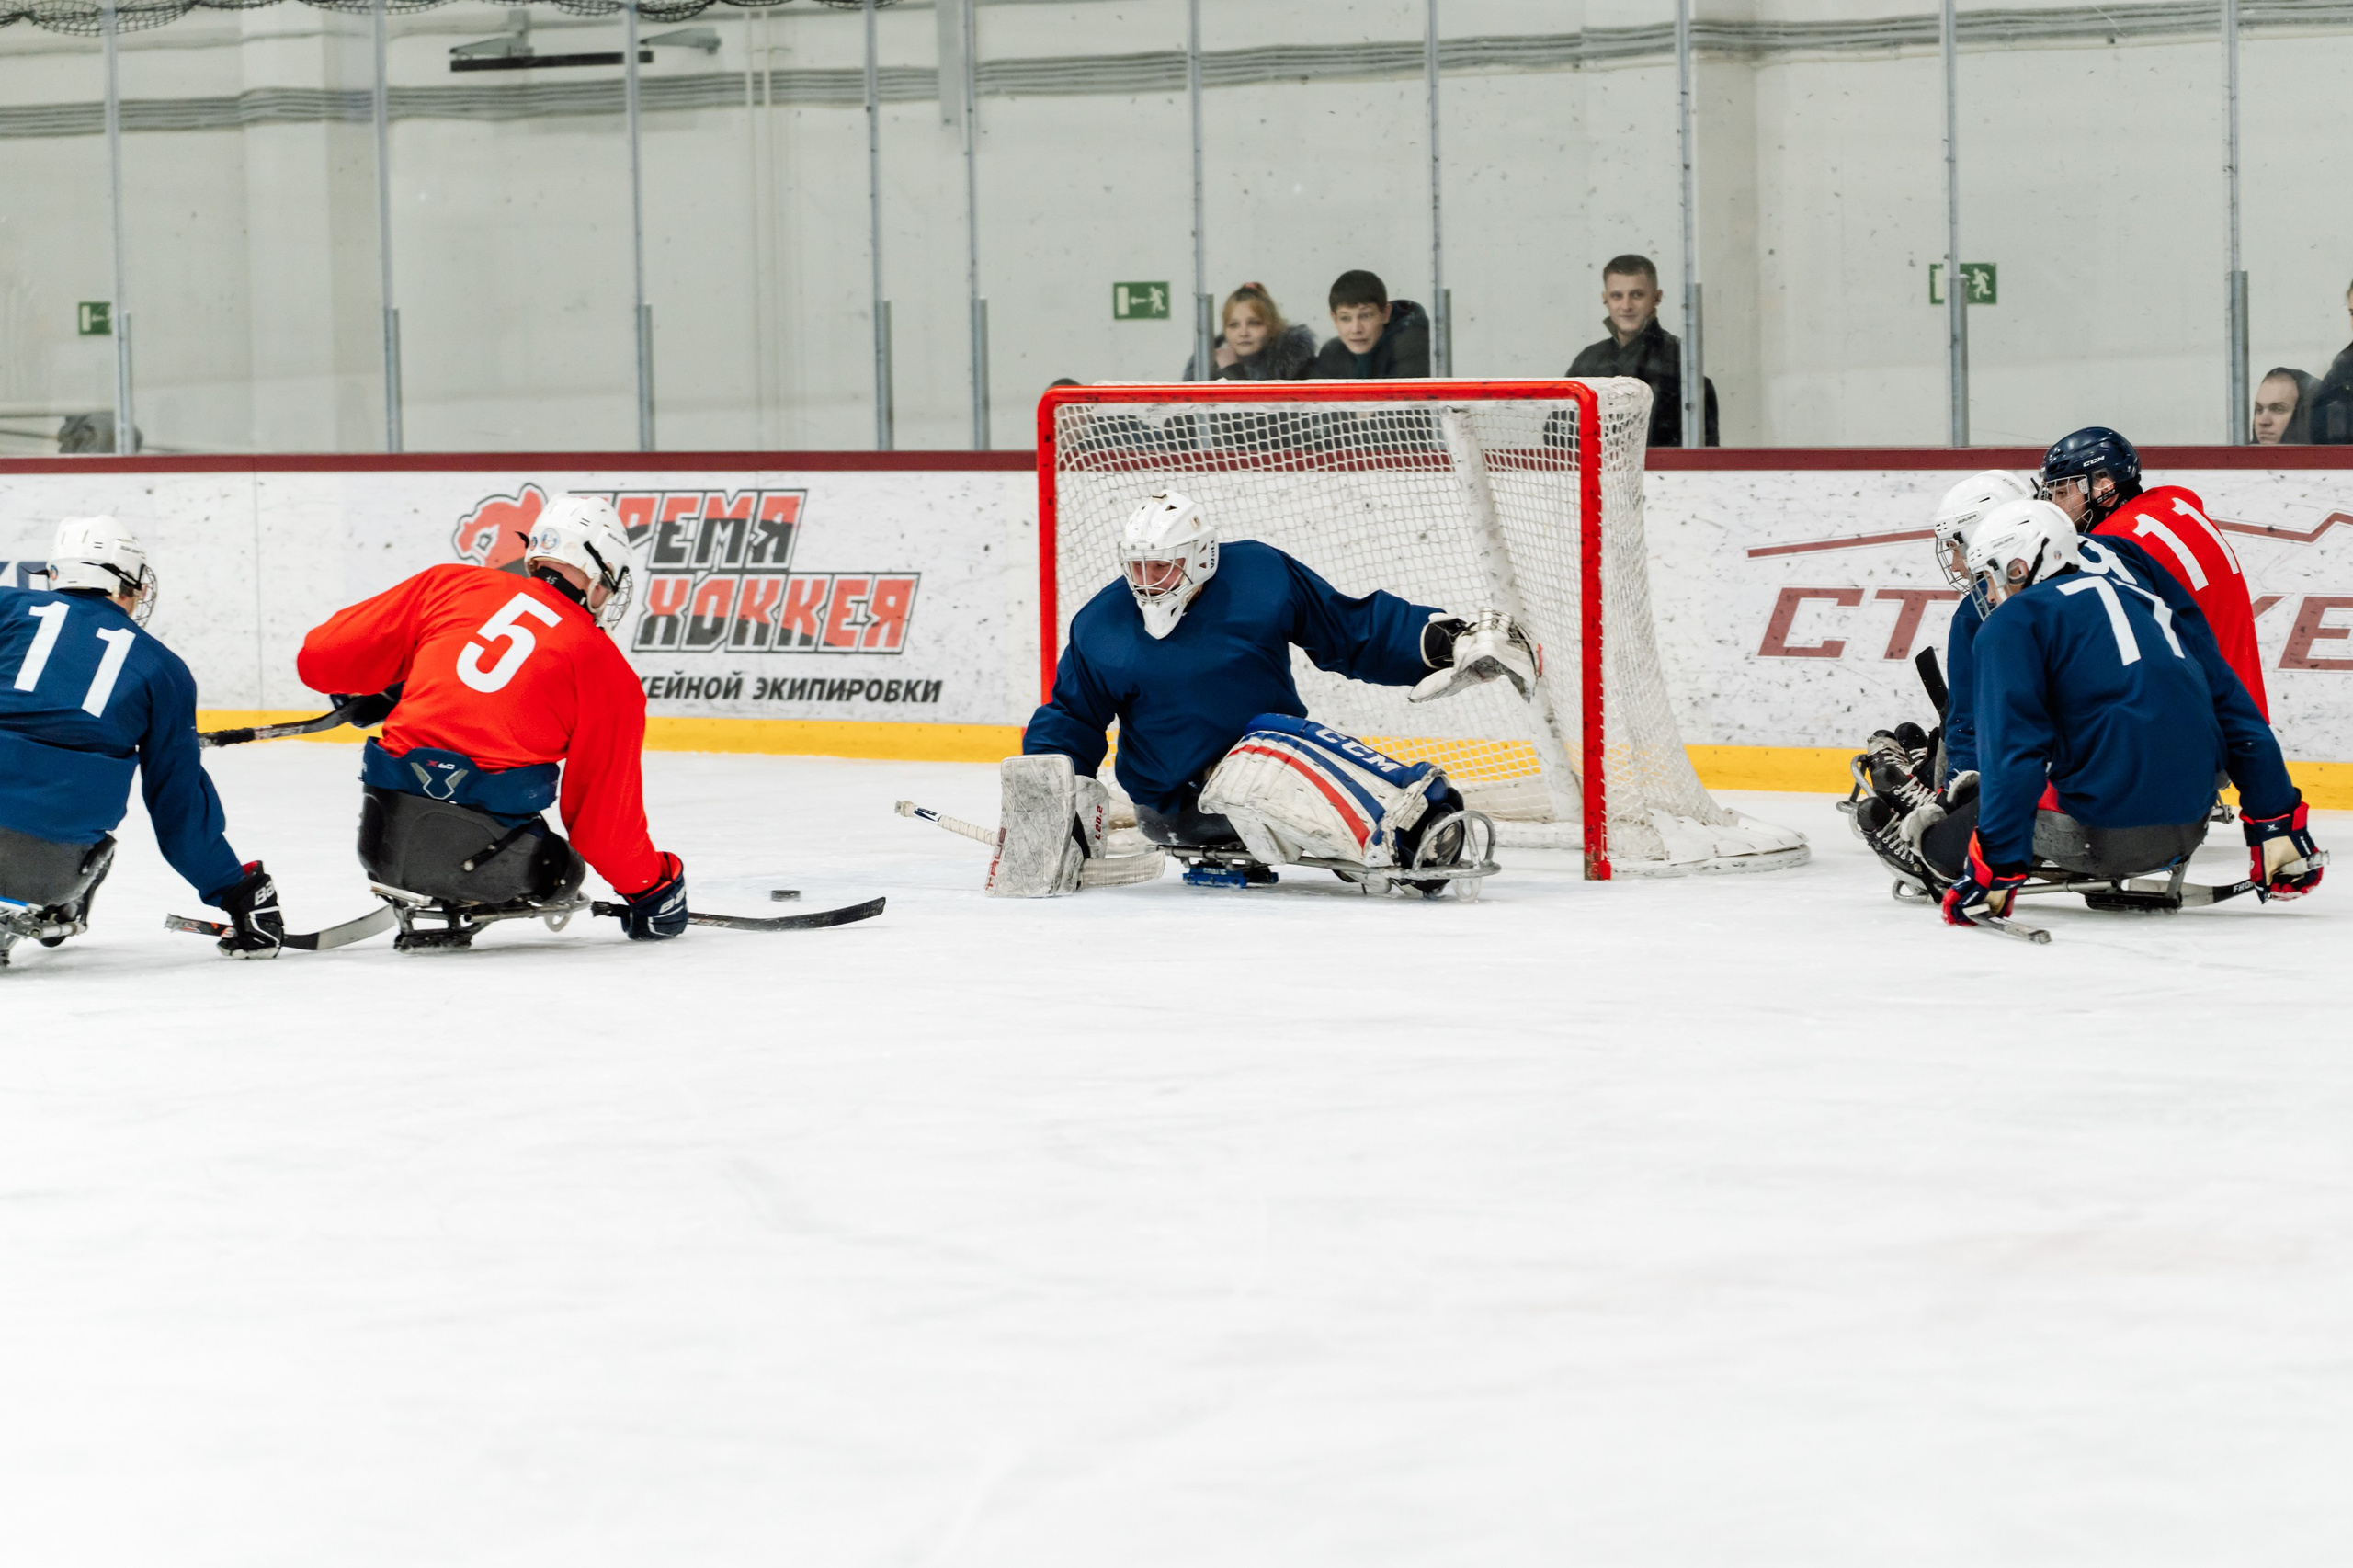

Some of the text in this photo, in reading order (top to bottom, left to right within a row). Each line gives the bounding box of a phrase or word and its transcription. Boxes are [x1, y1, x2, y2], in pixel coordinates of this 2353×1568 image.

[2083, 455, 2106, 468] CCM
[579, 488, 807, 568] РЕМЯ
[2132, 497, 2241, 592] 11
[456, 591, 563, 694] 5
[632, 572, 921, 654] ХОККЕЯ
[2055, 575, 2186, 667] 77
[13, 600, 137, 719] 11
[752, 677, 943, 703] ЭКИПИРОВКИ
[1314, 727, 1402, 773] CCM
